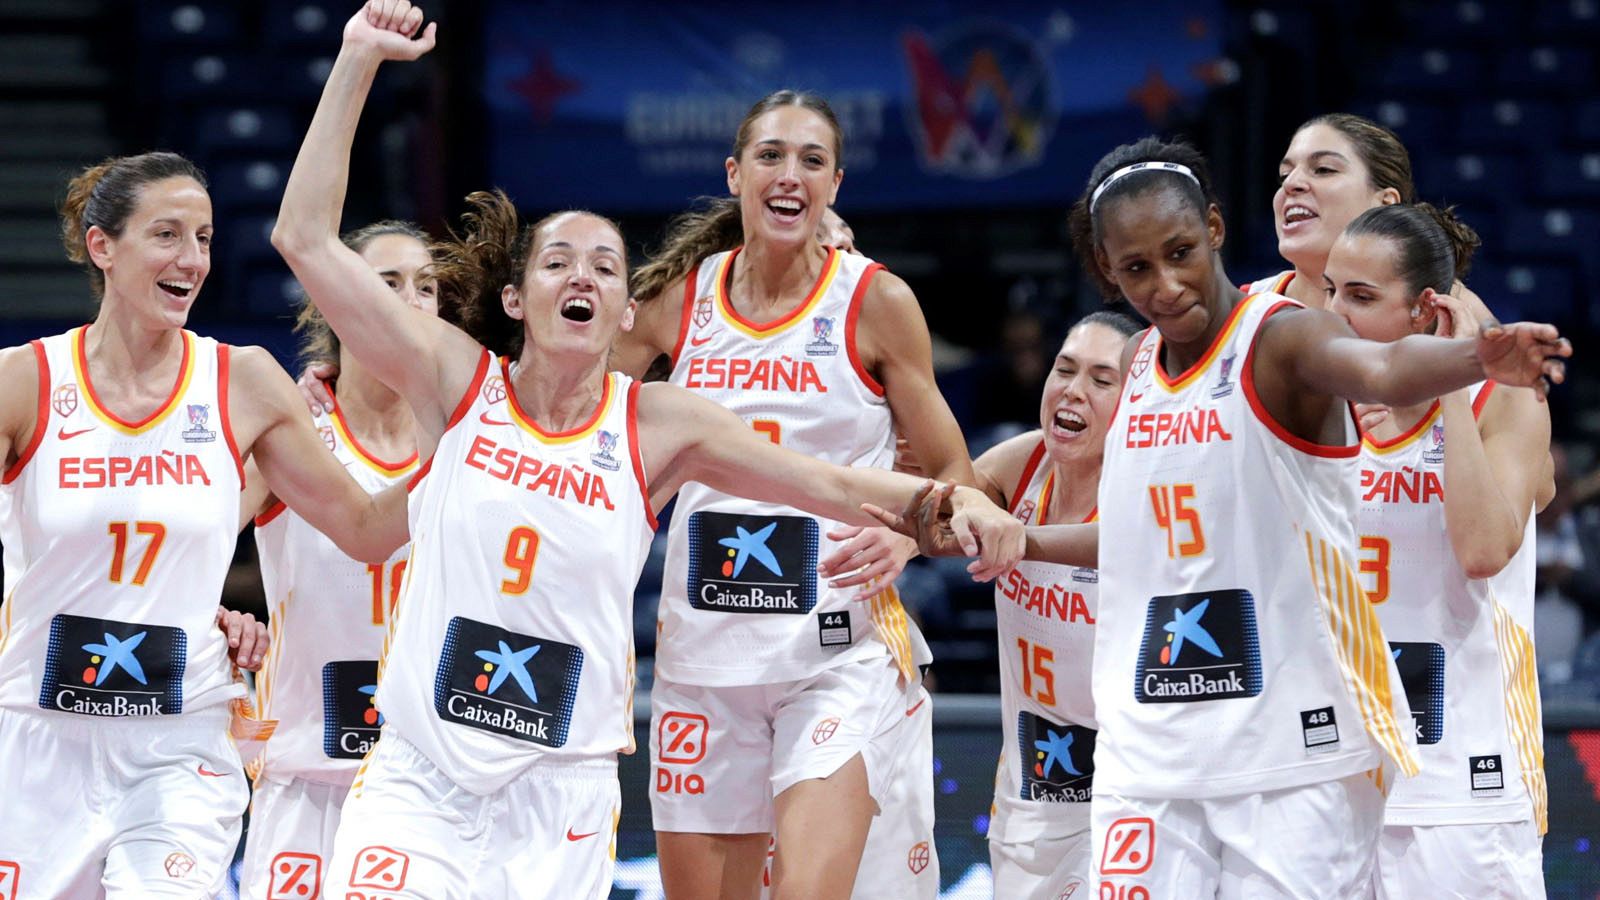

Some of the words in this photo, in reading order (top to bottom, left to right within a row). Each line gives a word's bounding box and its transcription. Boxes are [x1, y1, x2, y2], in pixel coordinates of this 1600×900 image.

[687, 357, 827, 392] ESPAÑA
[1127, 405, 1232, 448] ESPAÑA
[59, 449, 211, 489] ESPAÑA
[466, 435, 615, 511] ESPAÑA
[1149, 483, 1206, 558] 45
[108, 521, 168, 587] 17
[501, 525, 540, 596] 9
[1360, 536, 1391, 604] 3
[701, 583, 798, 609] CaixaBank
[997, 568, 1096, 625] SPAÑA
[825, 615, 843, 627] 44
[1017, 637, 1057, 707] 15
[1144, 670, 1245, 698] CaixaBank
[56, 689, 163, 716] CaixaBank
[448, 694, 550, 740] CaixaBank
[1308, 711, 1328, 724] 48
[1476, 757, 1496, 770] 46
